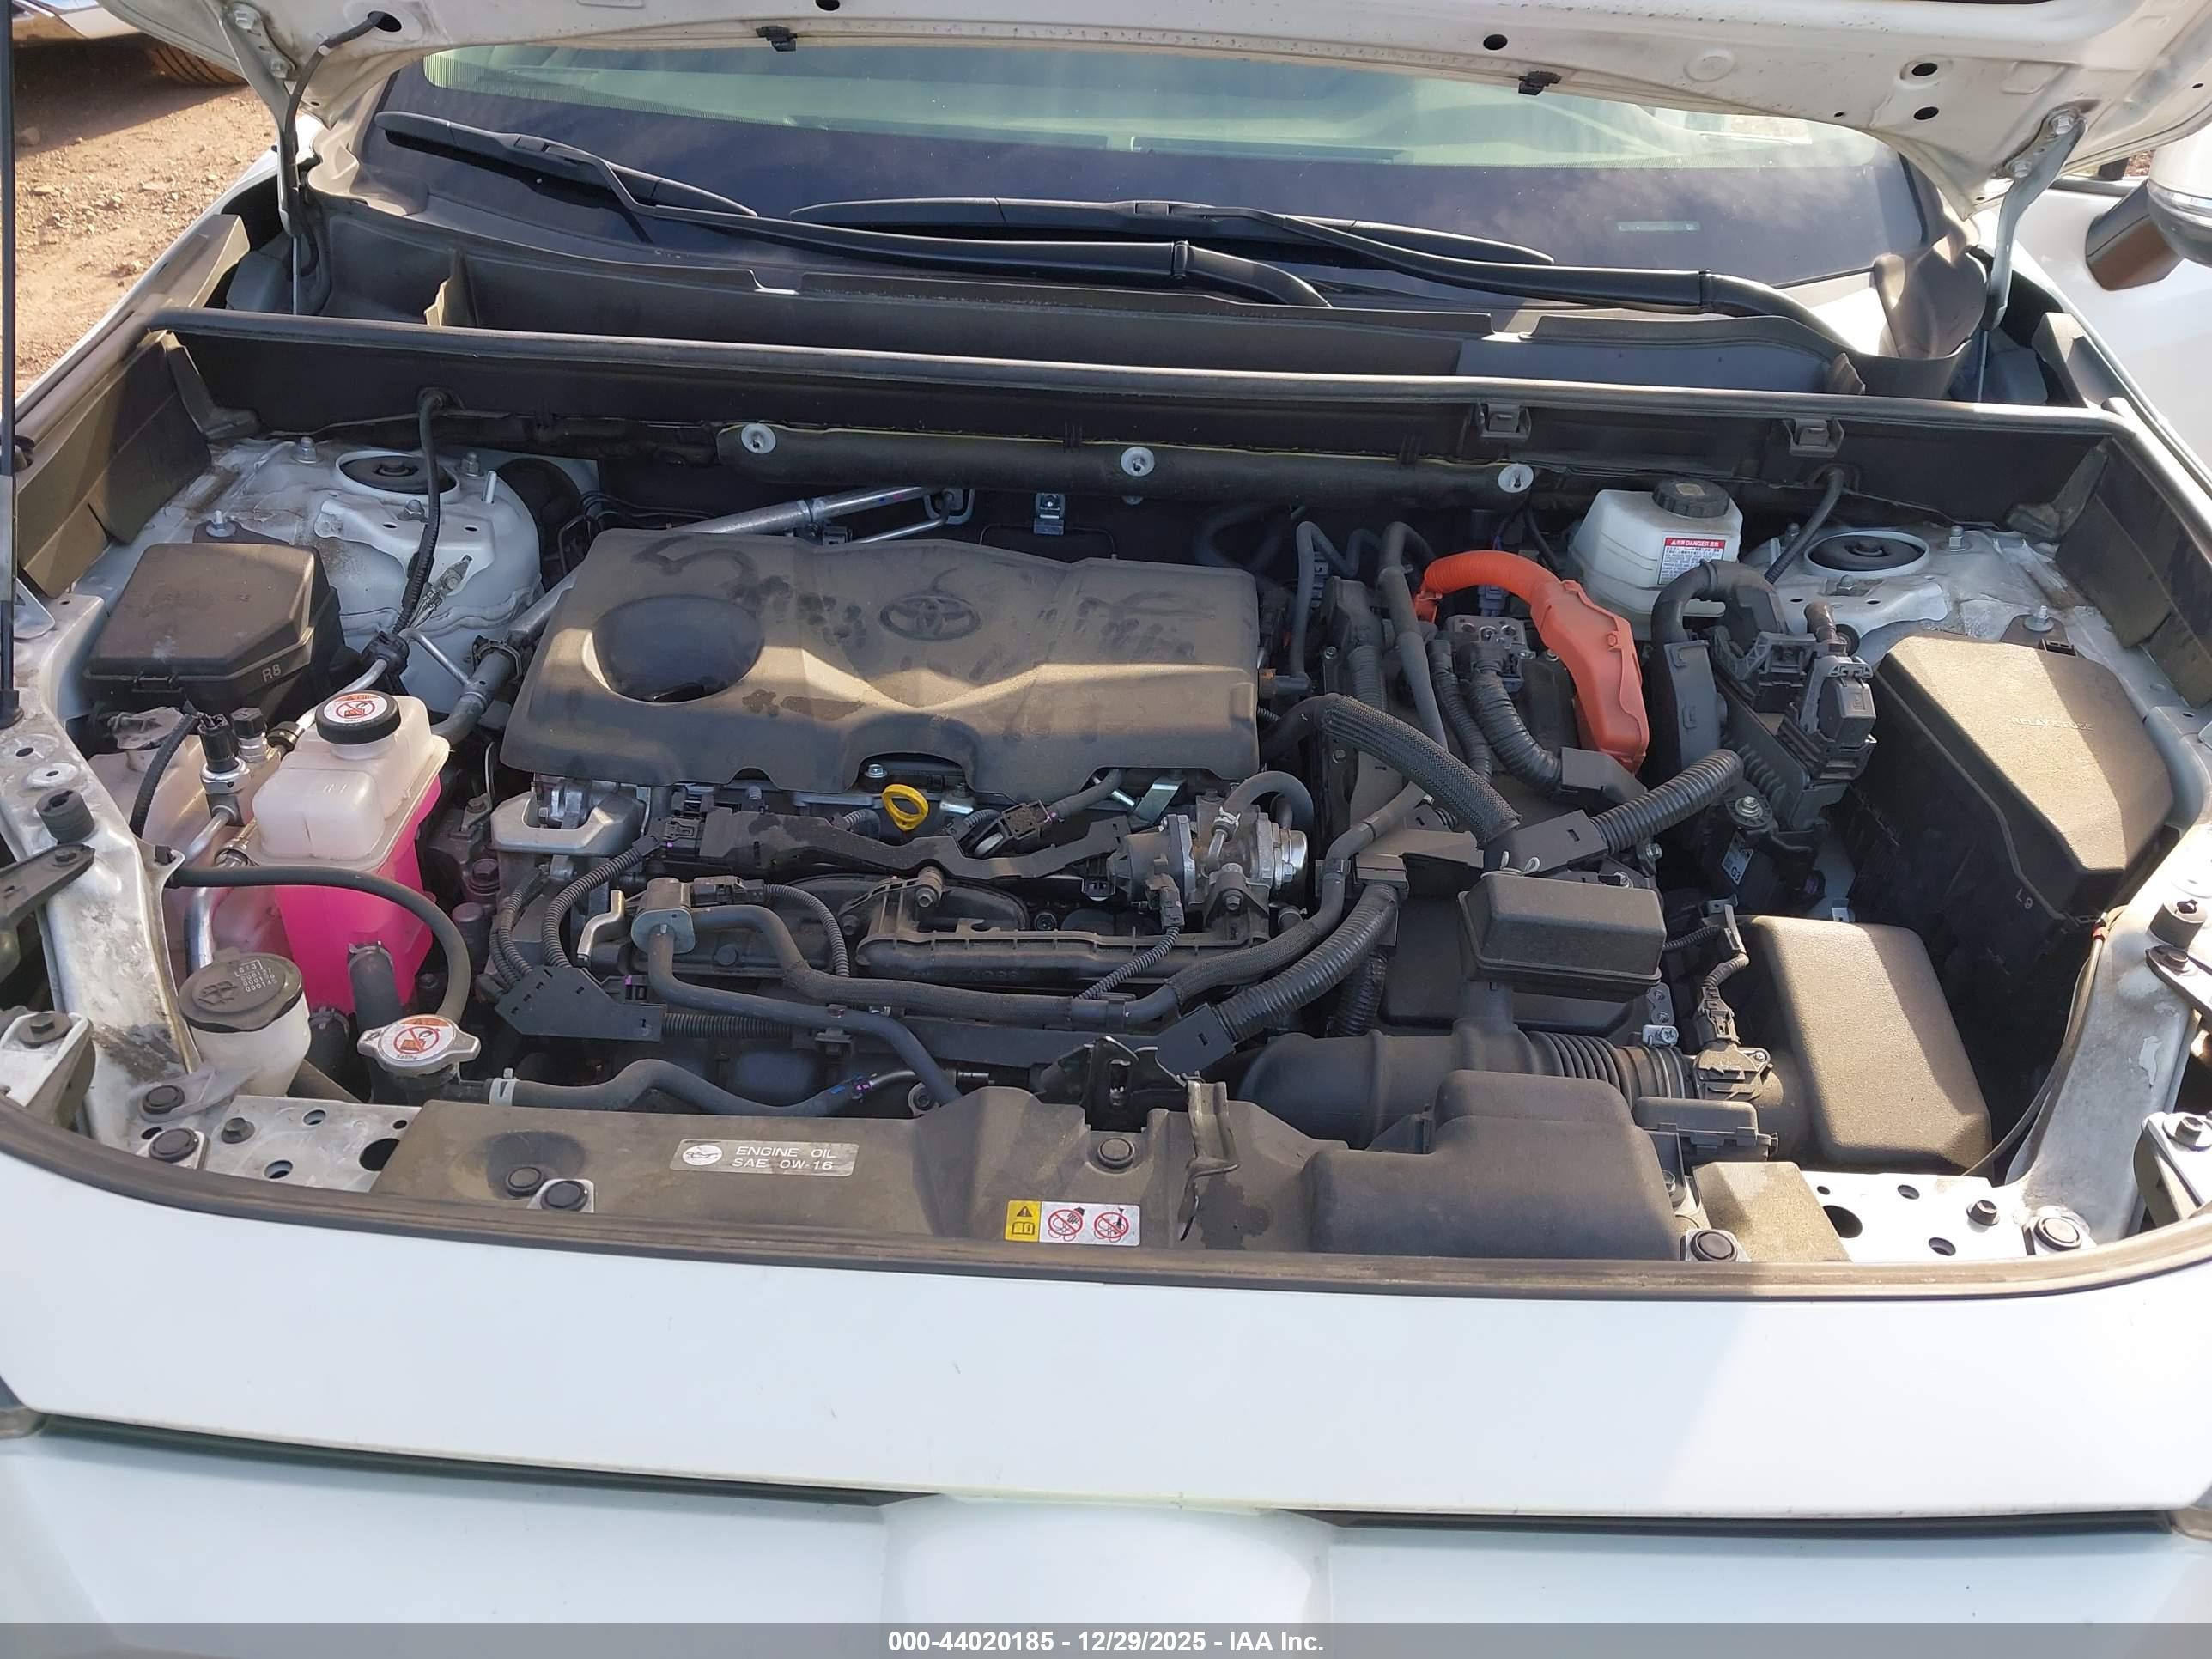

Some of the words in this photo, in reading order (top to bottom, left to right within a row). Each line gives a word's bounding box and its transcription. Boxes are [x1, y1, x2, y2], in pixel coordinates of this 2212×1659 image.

[262, 664, 282, 683] R8
[736, 1146, 799, 1158] ENGINE
[811, 1148, 837, 1158] OIL
[732, 1158, 769, 1169] SAE
